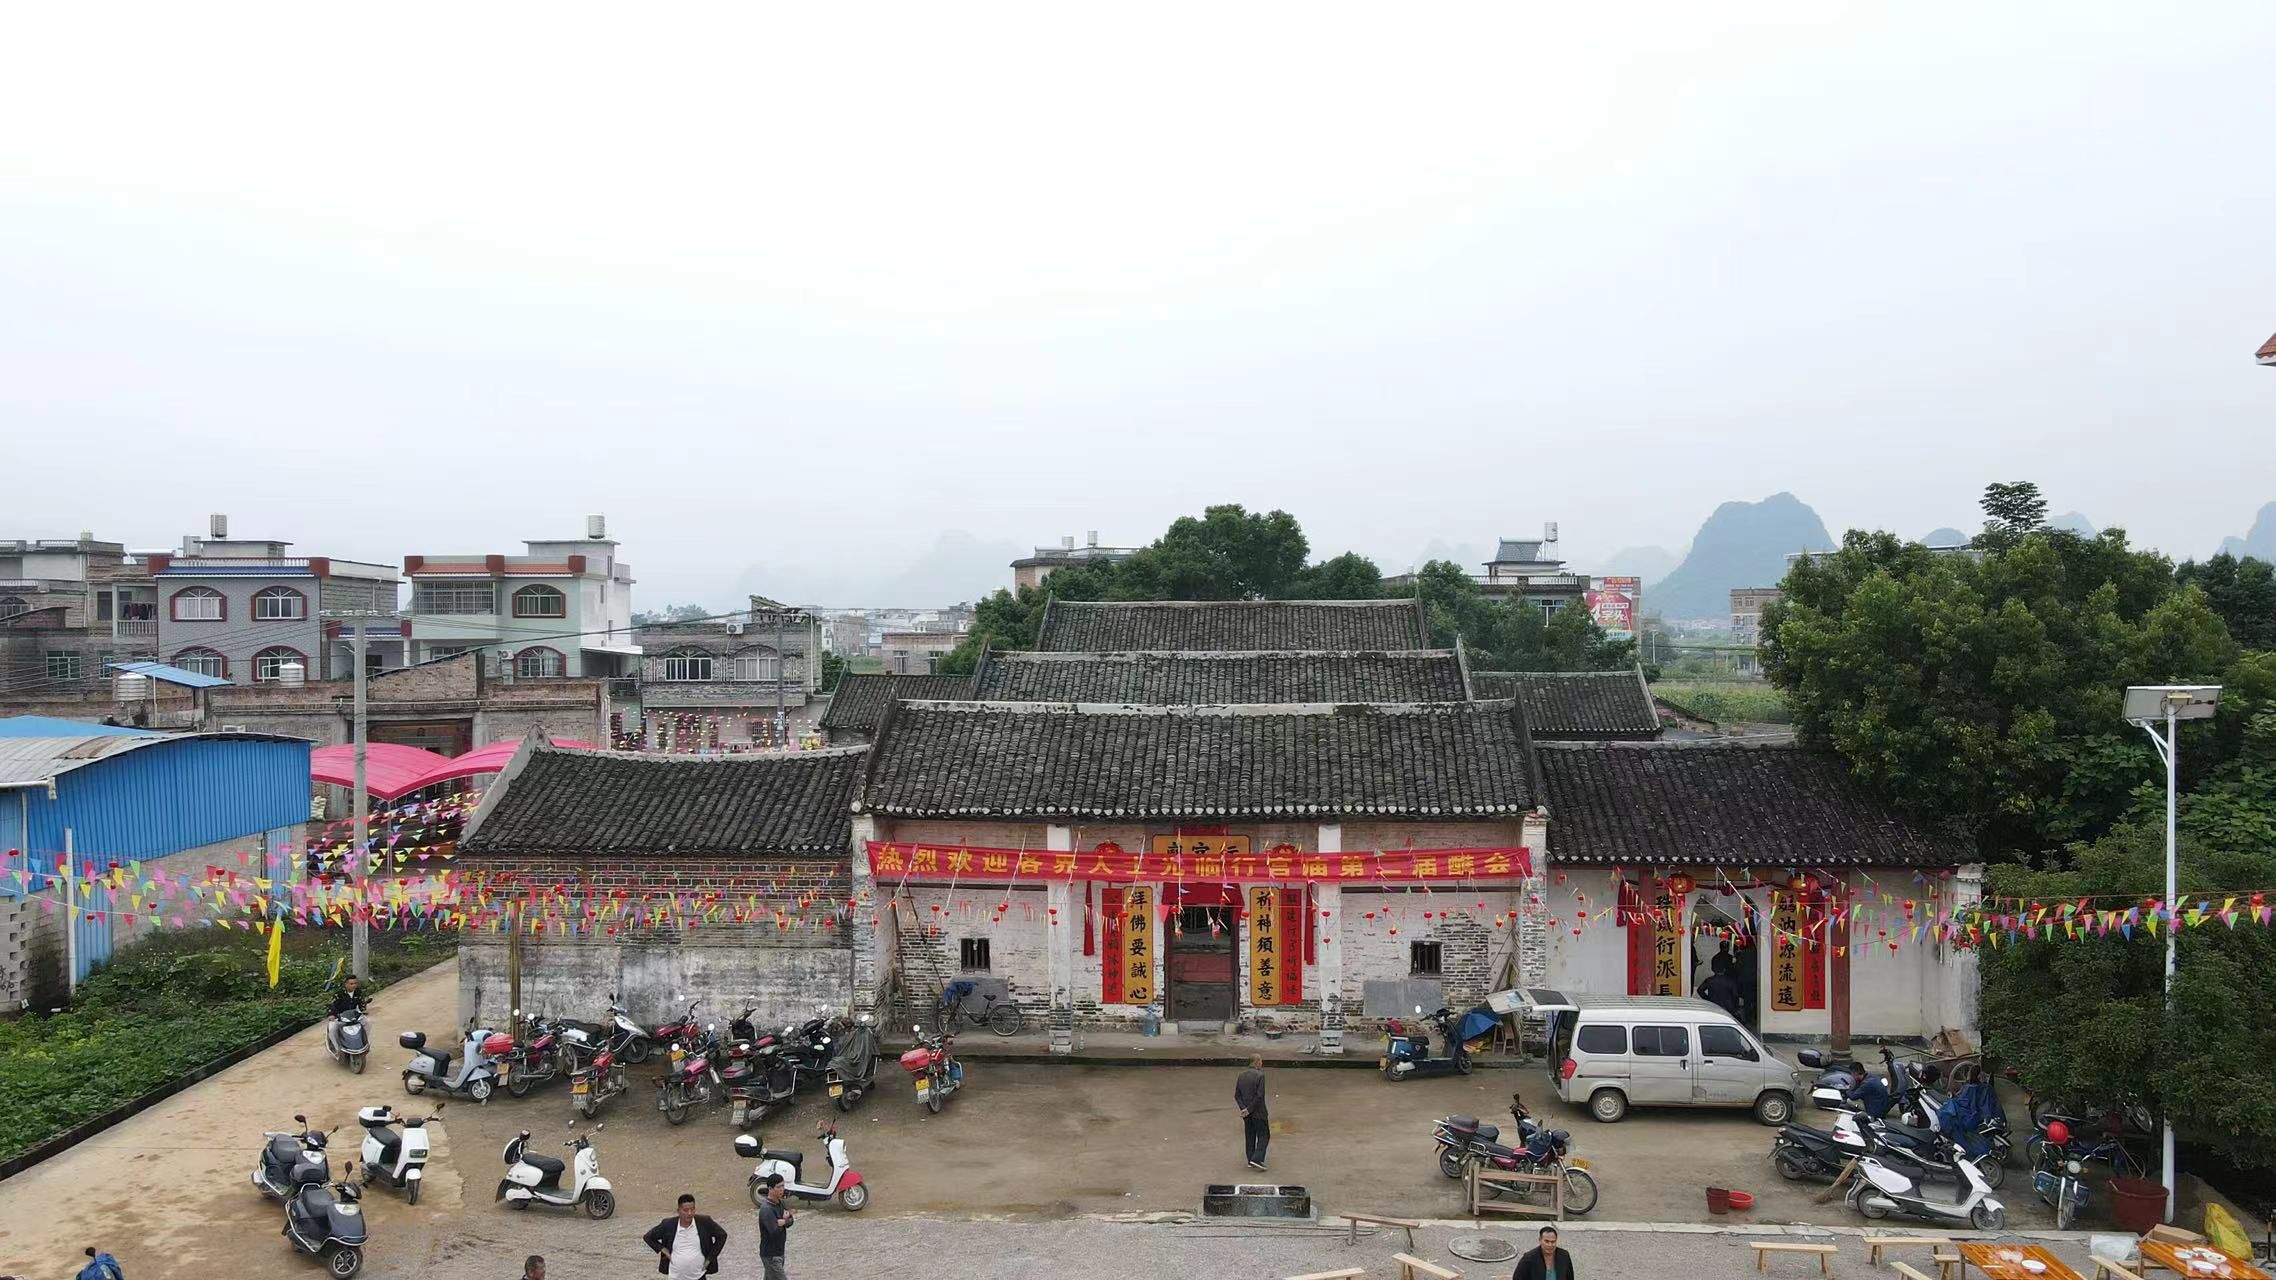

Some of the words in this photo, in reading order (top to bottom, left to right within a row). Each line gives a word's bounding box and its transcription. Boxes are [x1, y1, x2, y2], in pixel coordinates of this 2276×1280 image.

[1257, 891, 1274, 1000] 祈神須善意
